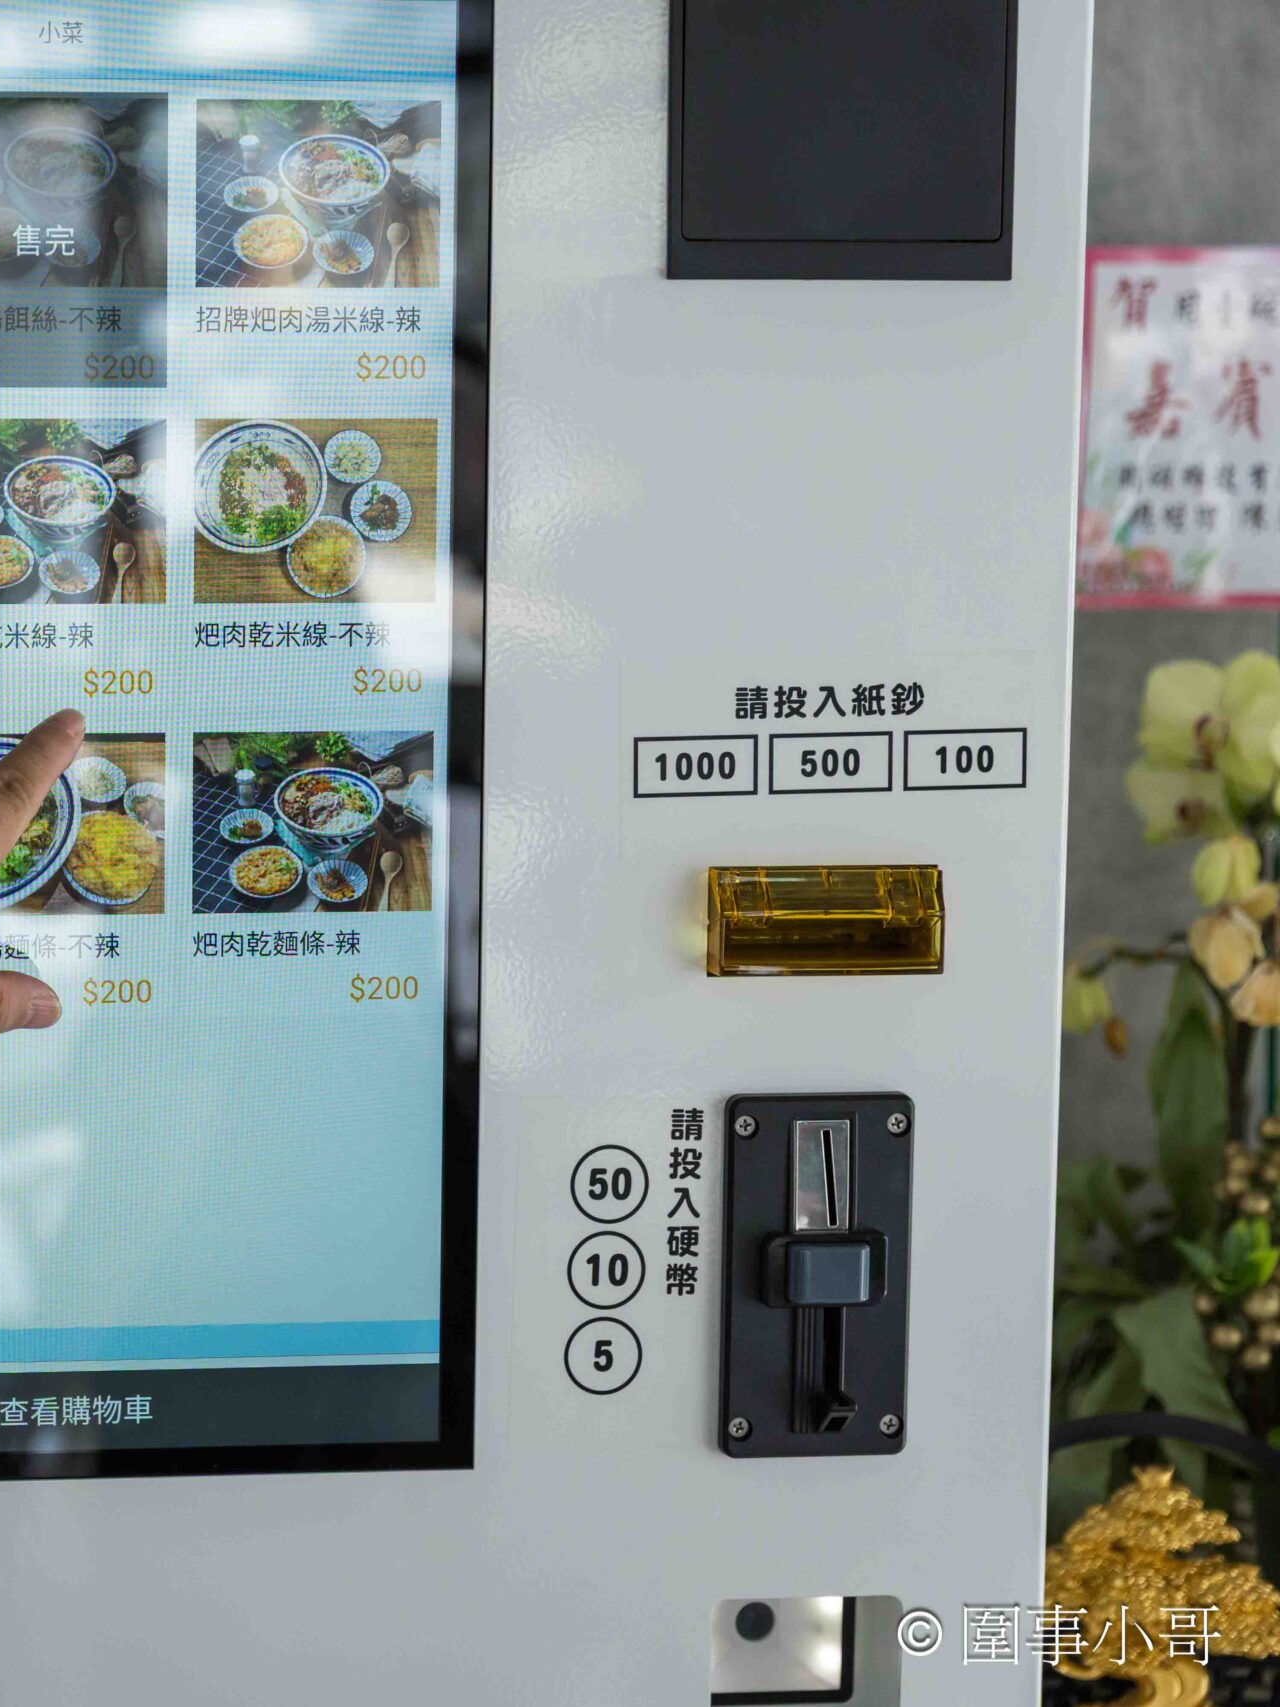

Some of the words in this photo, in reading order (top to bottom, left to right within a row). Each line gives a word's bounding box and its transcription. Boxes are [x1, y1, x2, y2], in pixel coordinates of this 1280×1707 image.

[39, 20, 84, 44] 小菜
[12, 224, 75, 257] 售完
[84, 352, 155, 382] $200
[356, 352, 426, 382] $200
[83, 667, 154, 697] $200
[353, 666, 422, 695] $200
[734, 682, 925, 720] 請投入紙鈔
[654, 750, 737, 781] 1000
[799, 747, 862, 778] 500
[934, 744, 996, 775] 100
[83, 978, 152, 1006] $200
[350, 973, 419, 1003] $200
[588, 1167, 632, 1201] 50
[665, 1107, 704, 1297] 請投入硬幣
[586, 1253, 629, 1287] 10
[593, 1339, 614, 1373] 5
[0, 1394, 154, 1427] 查看購物車
